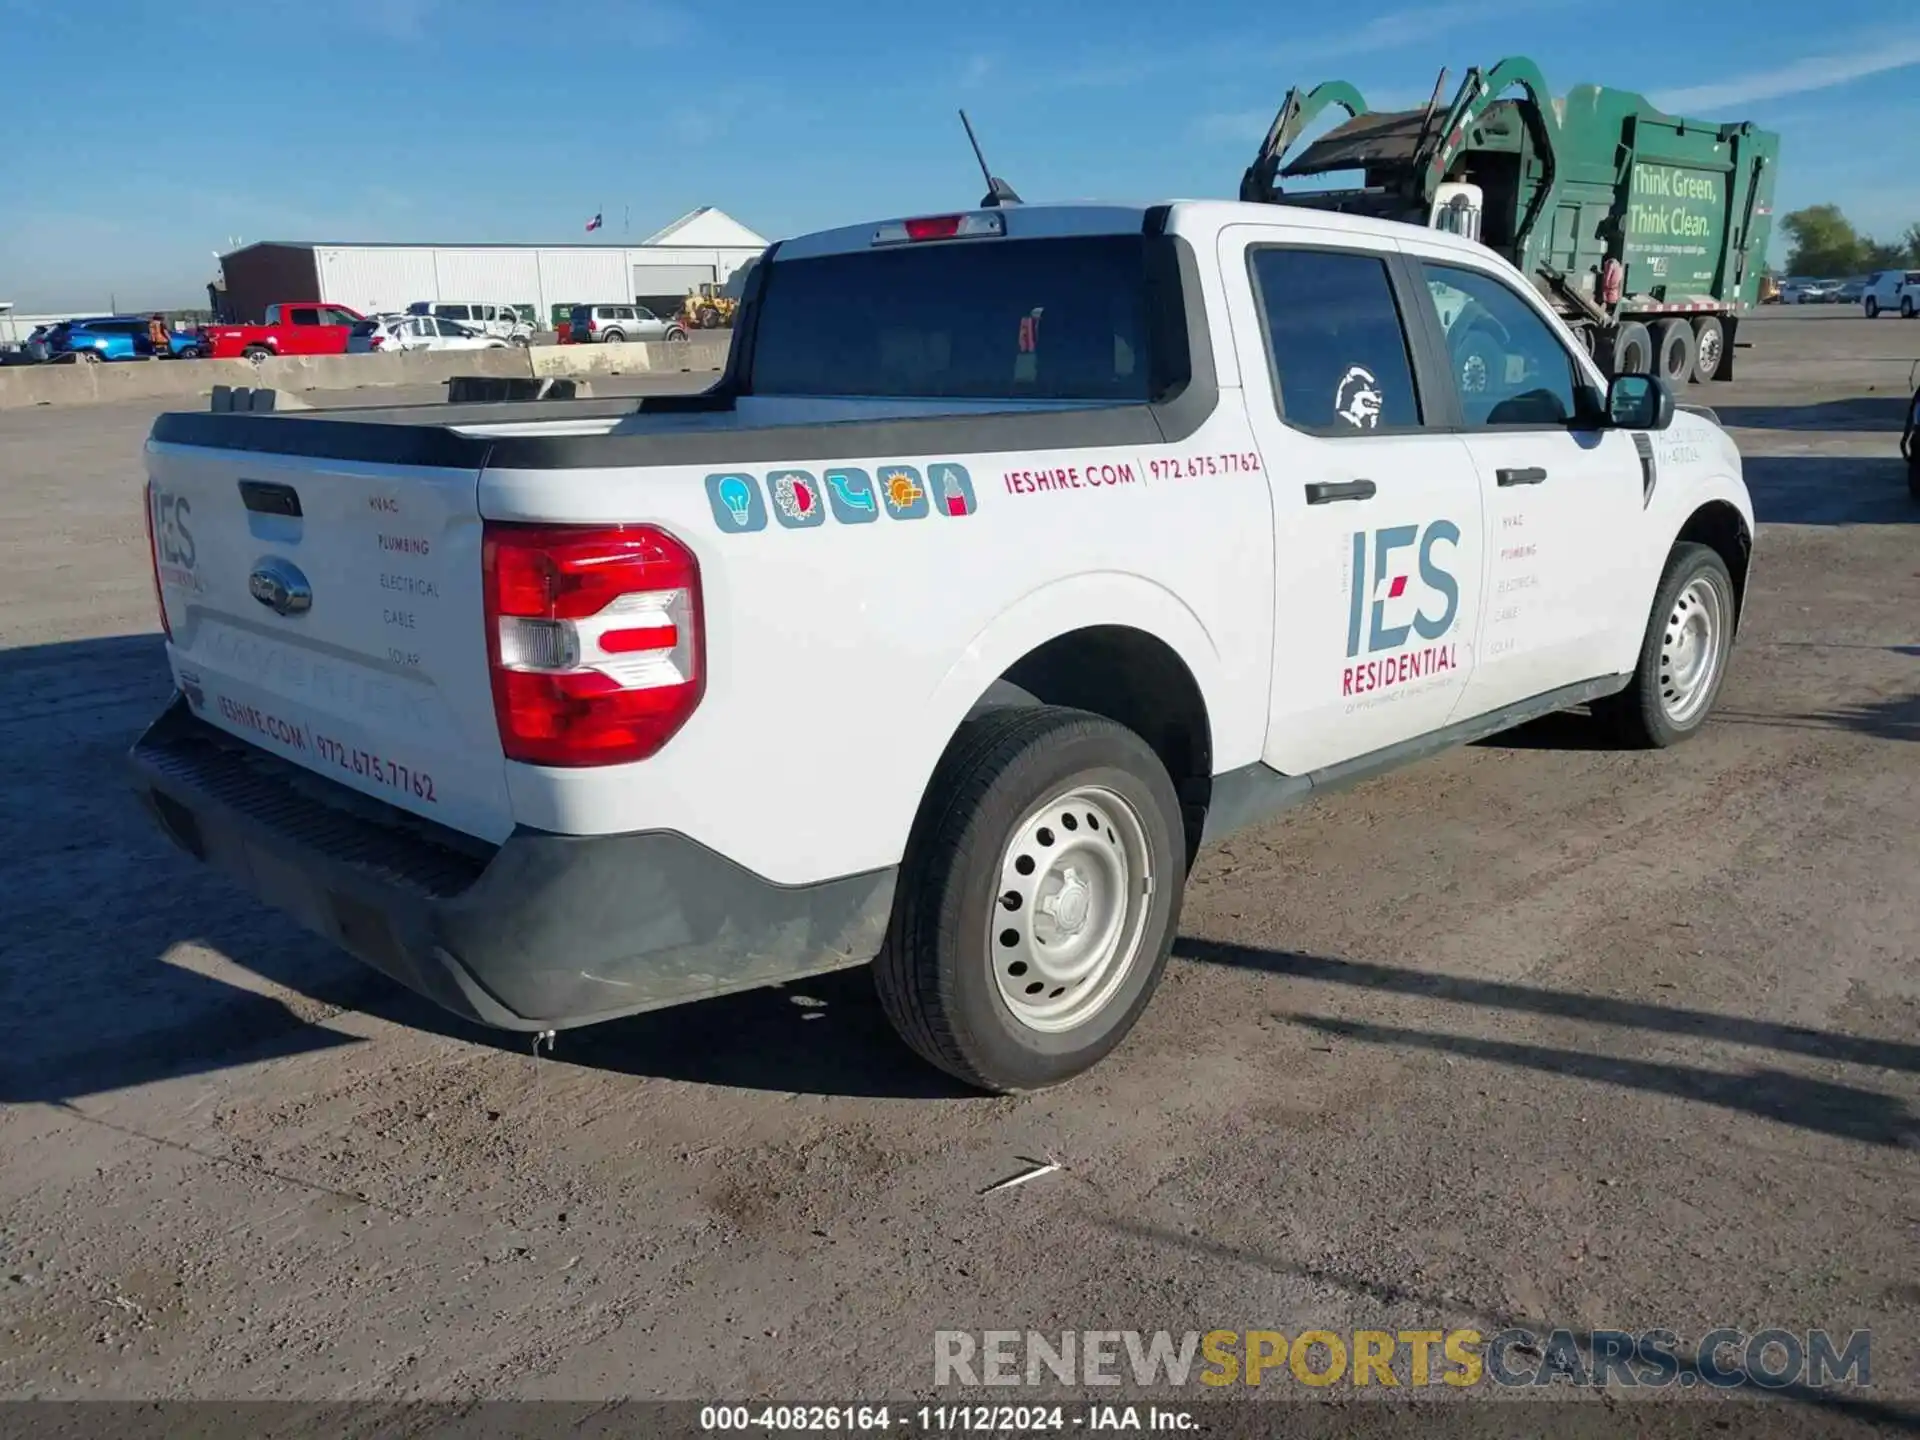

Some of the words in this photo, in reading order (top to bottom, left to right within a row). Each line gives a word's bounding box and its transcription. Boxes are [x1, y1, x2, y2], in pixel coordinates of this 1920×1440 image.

[1635, 163, 1669, 196] Think
[1673, 170, 1716, 204] Green,
[1631, 203, 1668, 235] Think
[1671, 207, 1710, 237] Clean.
[1004, 463, 1135, 495] IESHIRE.COM
[1150, 452, 1261, 480] 972.675.7762
[378, 533, 430, 555] PLUMBING
[380, 573, 440, 598] ELECTRICAL
[1347, 519, 1460, 658] IES
[1343, 643, 1457, 697] RESIDENTIAL
[217, 695, 305, 750] IESHIRE.COM
[317, 735, 437, 803] 972.675.7762
